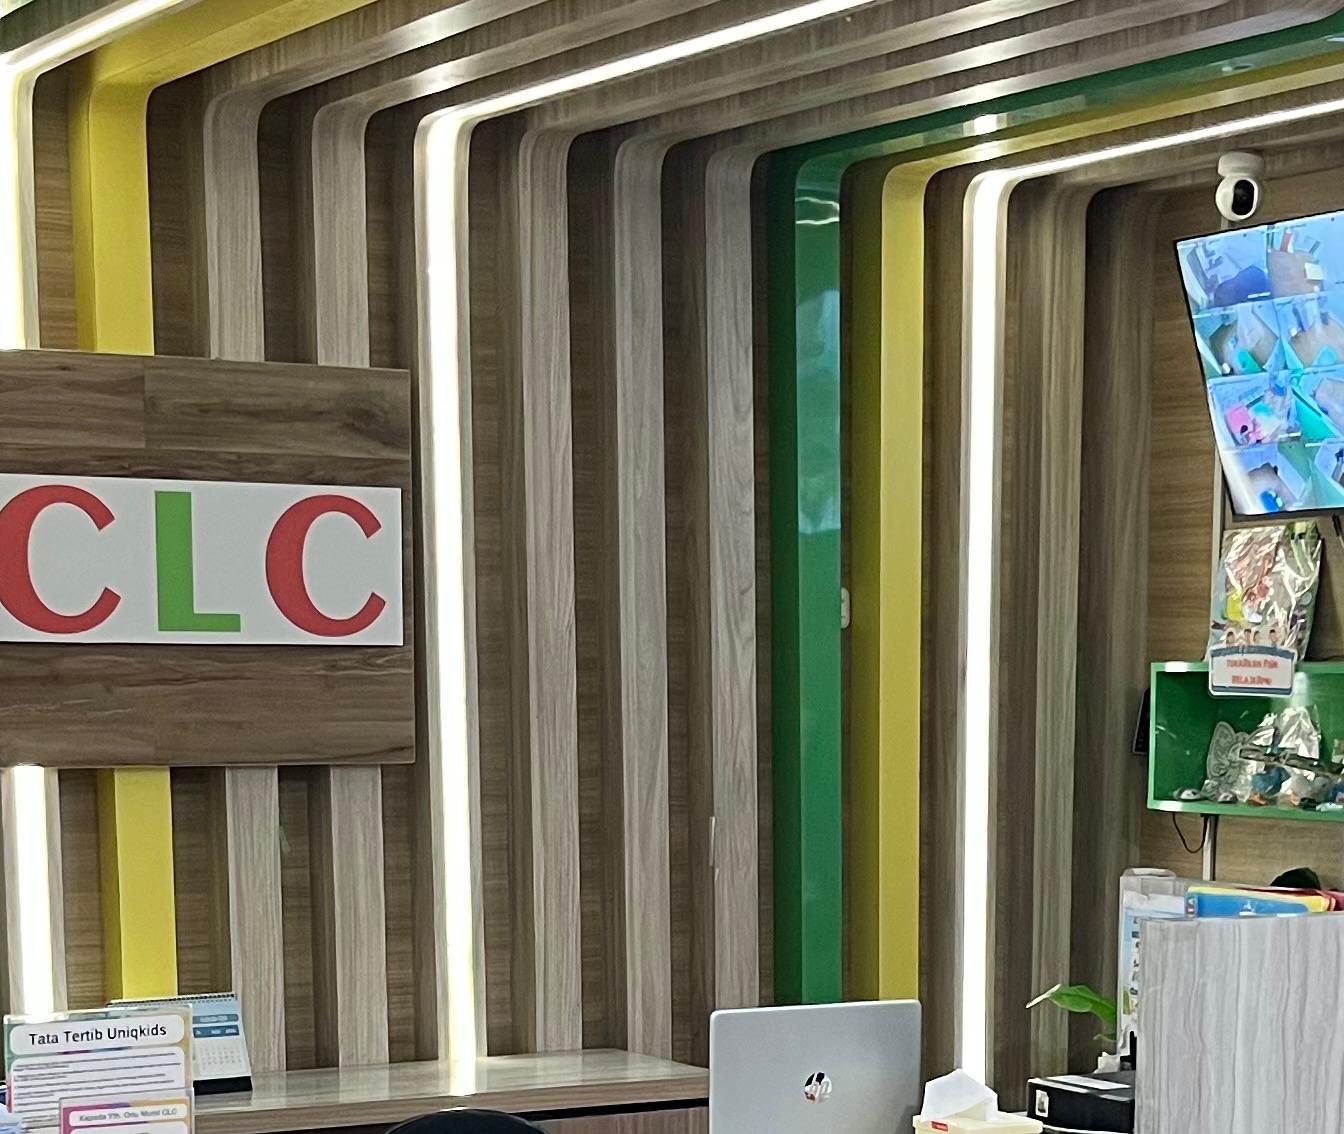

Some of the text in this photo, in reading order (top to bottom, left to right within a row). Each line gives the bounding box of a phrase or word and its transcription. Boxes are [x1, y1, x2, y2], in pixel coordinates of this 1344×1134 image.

[29, 1024, 167, 1046] Tata Tertib Uniqkids
